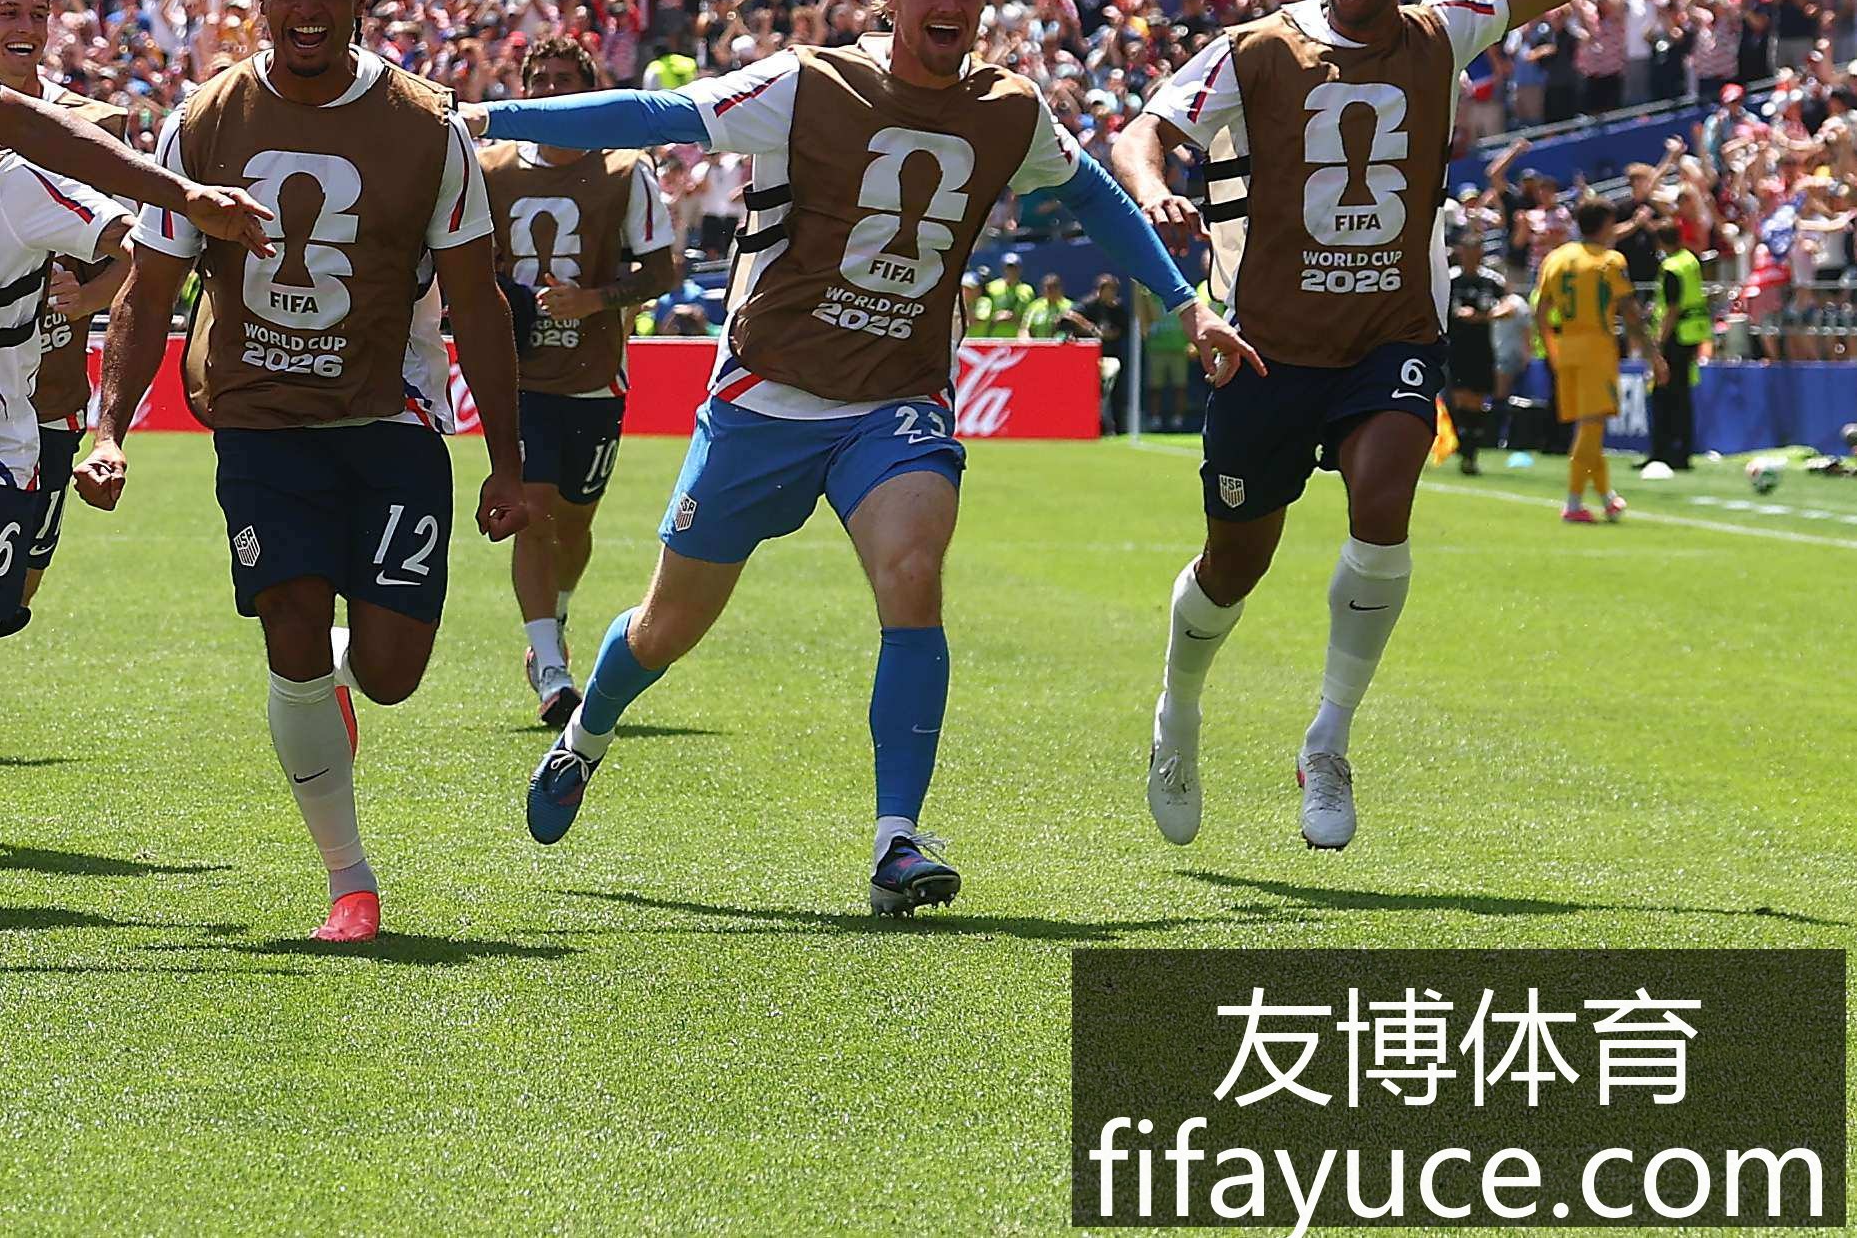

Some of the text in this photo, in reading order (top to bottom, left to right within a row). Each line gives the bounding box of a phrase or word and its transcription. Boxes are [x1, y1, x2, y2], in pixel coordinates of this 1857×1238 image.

[1335, 213, 1382, 231] FIFA
[1302, 250, 1403, 267] WORLD CUP
[869, 260, 916, 284] FIFA
[1301, 268, 1401, 293] 2026
[270, 292, 319, 313] FIFA
[825, 286, 891, 311] WORLD
[811, 302, 913, 339] 2026
[40, 325, 72, 353] 26
[244, 322, 347, 351] WORLD CUP
[530, 330, 579, 347] 026
[242, 341, 344, 377] 2026
[1401, 358, 1427, 386] 6
[586, 439, 618, 482] 10
[1221, 477, 1242, 490] USA
[236, 528, 253, 548] USA
[373, 505, 438, 576] 12
